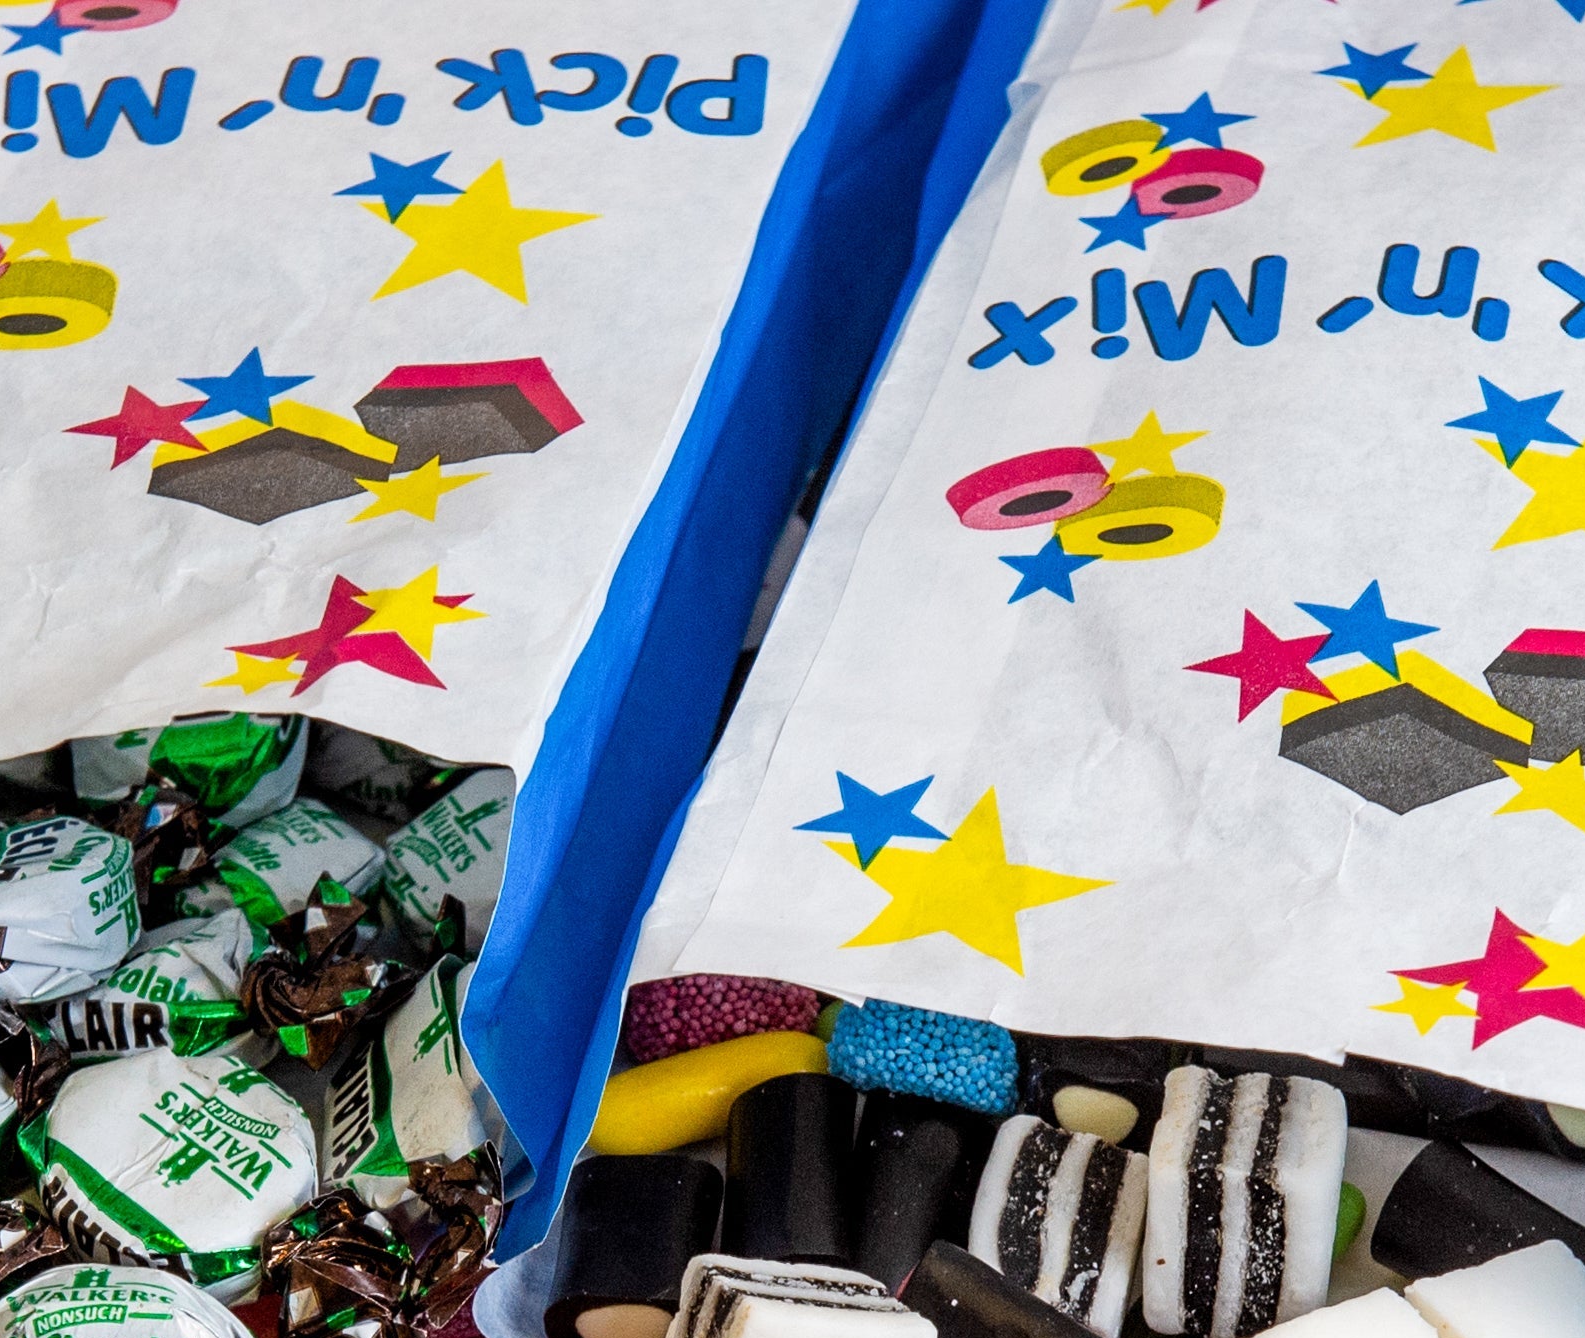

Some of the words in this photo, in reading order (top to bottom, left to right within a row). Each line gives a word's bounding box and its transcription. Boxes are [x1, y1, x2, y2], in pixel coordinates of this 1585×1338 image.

[436, 48, 770, 138] Pick
[968, 255, 1288, 371] Mix
[154, 1090, 274, 1192] WALKER'S
[204, 1098, 278, 1139] NONSUCH
[36, 1305, 126, 1335] NONSUCH
